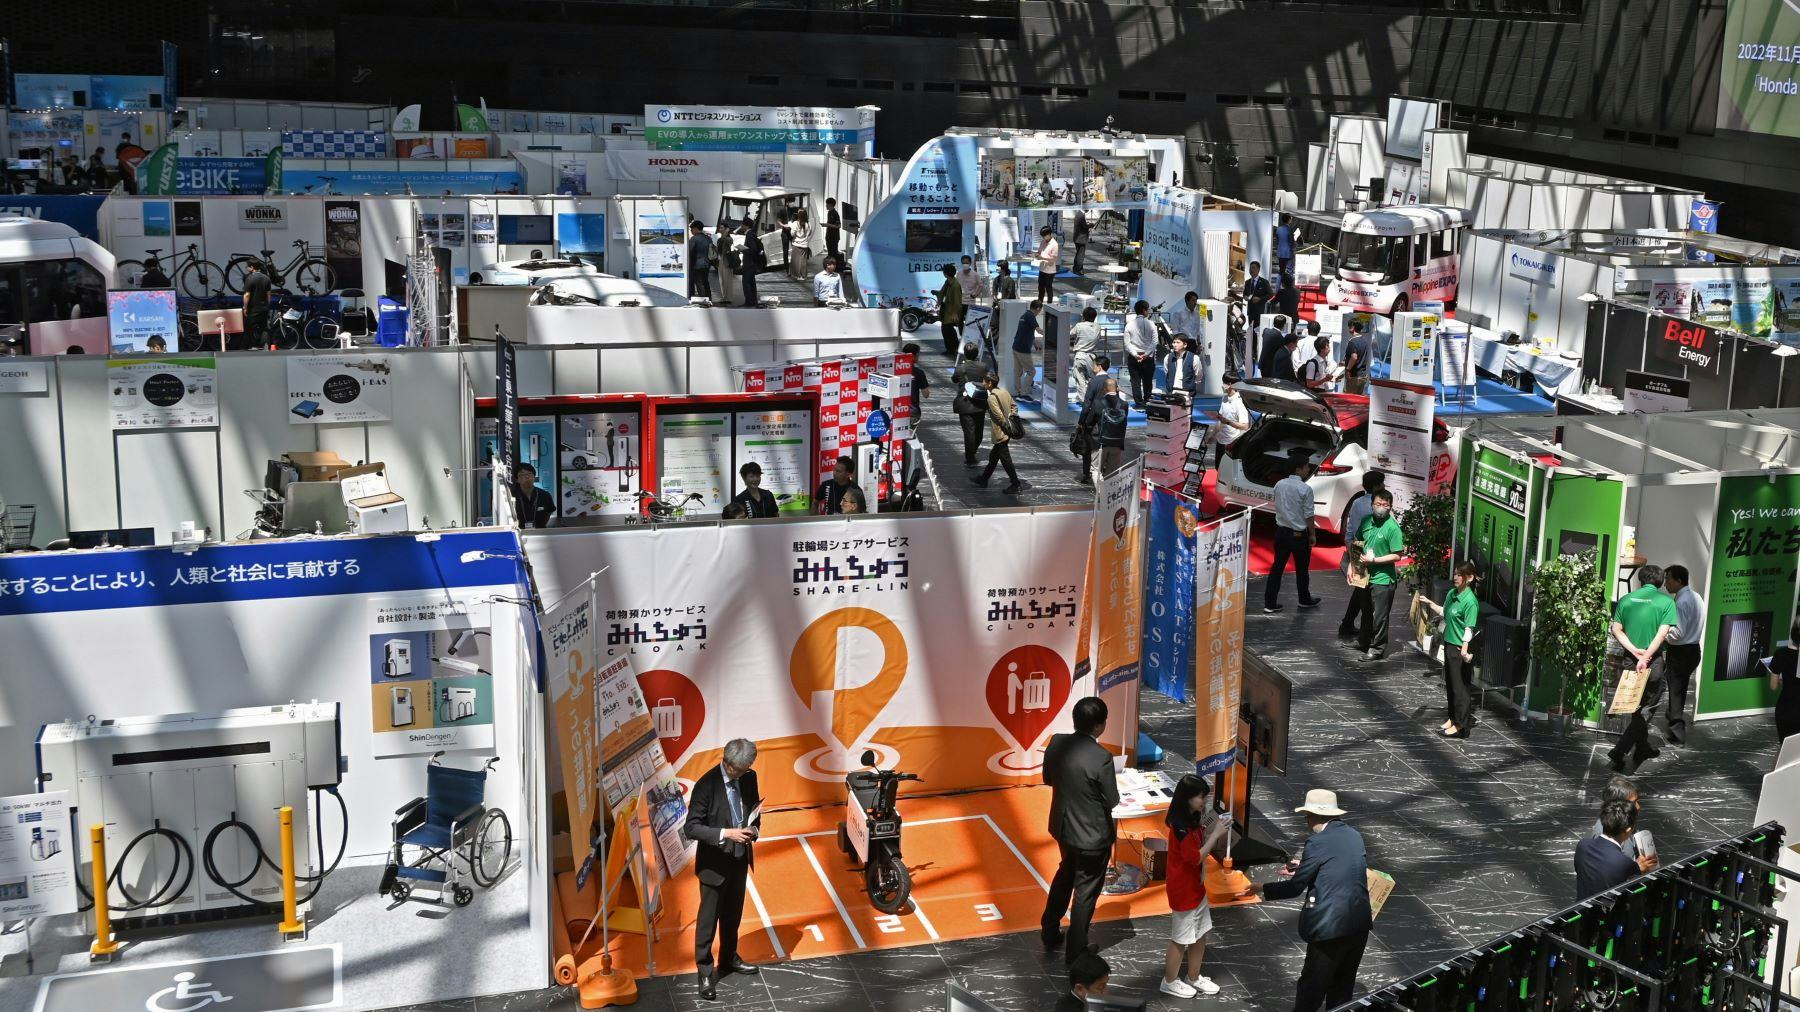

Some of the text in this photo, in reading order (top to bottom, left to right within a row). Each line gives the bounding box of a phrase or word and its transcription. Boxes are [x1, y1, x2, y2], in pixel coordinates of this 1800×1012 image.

[674, 112, 762, 122] NTTビジネスソリューションズ
[648, 158, 700, 166] HONDA
[909, 183, 958, 192] 移動でもっと
[909, 195, 958, 203] できることを
[246, 209, 282, 218] WONKA
[328, 210, 358, 220] WONKA
[1520, 258, 1556, 273] TOKAIGIKEN
[1412, 275, 1456, 294] Philippine EXPO
[1338, 287, 1361, 298] Philippine
[1664, 320, 1706, 350] Bell
[1678, 346, 1711, 368] Energy
[1732, 508, 1754, 524] Yes!
[1760, 508, 1778, 518] We
[793, 537, 909, 552] 駐輪場シェアサービス
[1726, 525, 1800, 559] 私たち
[793, 553, 908, 583] みんちゅう
[793, 582, 908, 596] SHARE-LIN
[988, 586, 1076, 598] 荷物預かりサービス
[606, 605, 707, 620] 荷物預かりサービス
[988, 598, 1076, 621] みんちゅう
[608, 620, 707, 645] みんちゅう
[988, 620, 1074, 632] CLOAK
[607, 642, 708, 656] CLOAK
[409, 732, 452, 742] ShinDengen
[974, 903, 1002, 922] 3
[875, 914, 906, 933] 2
[804, 924, 824, 942] 1
